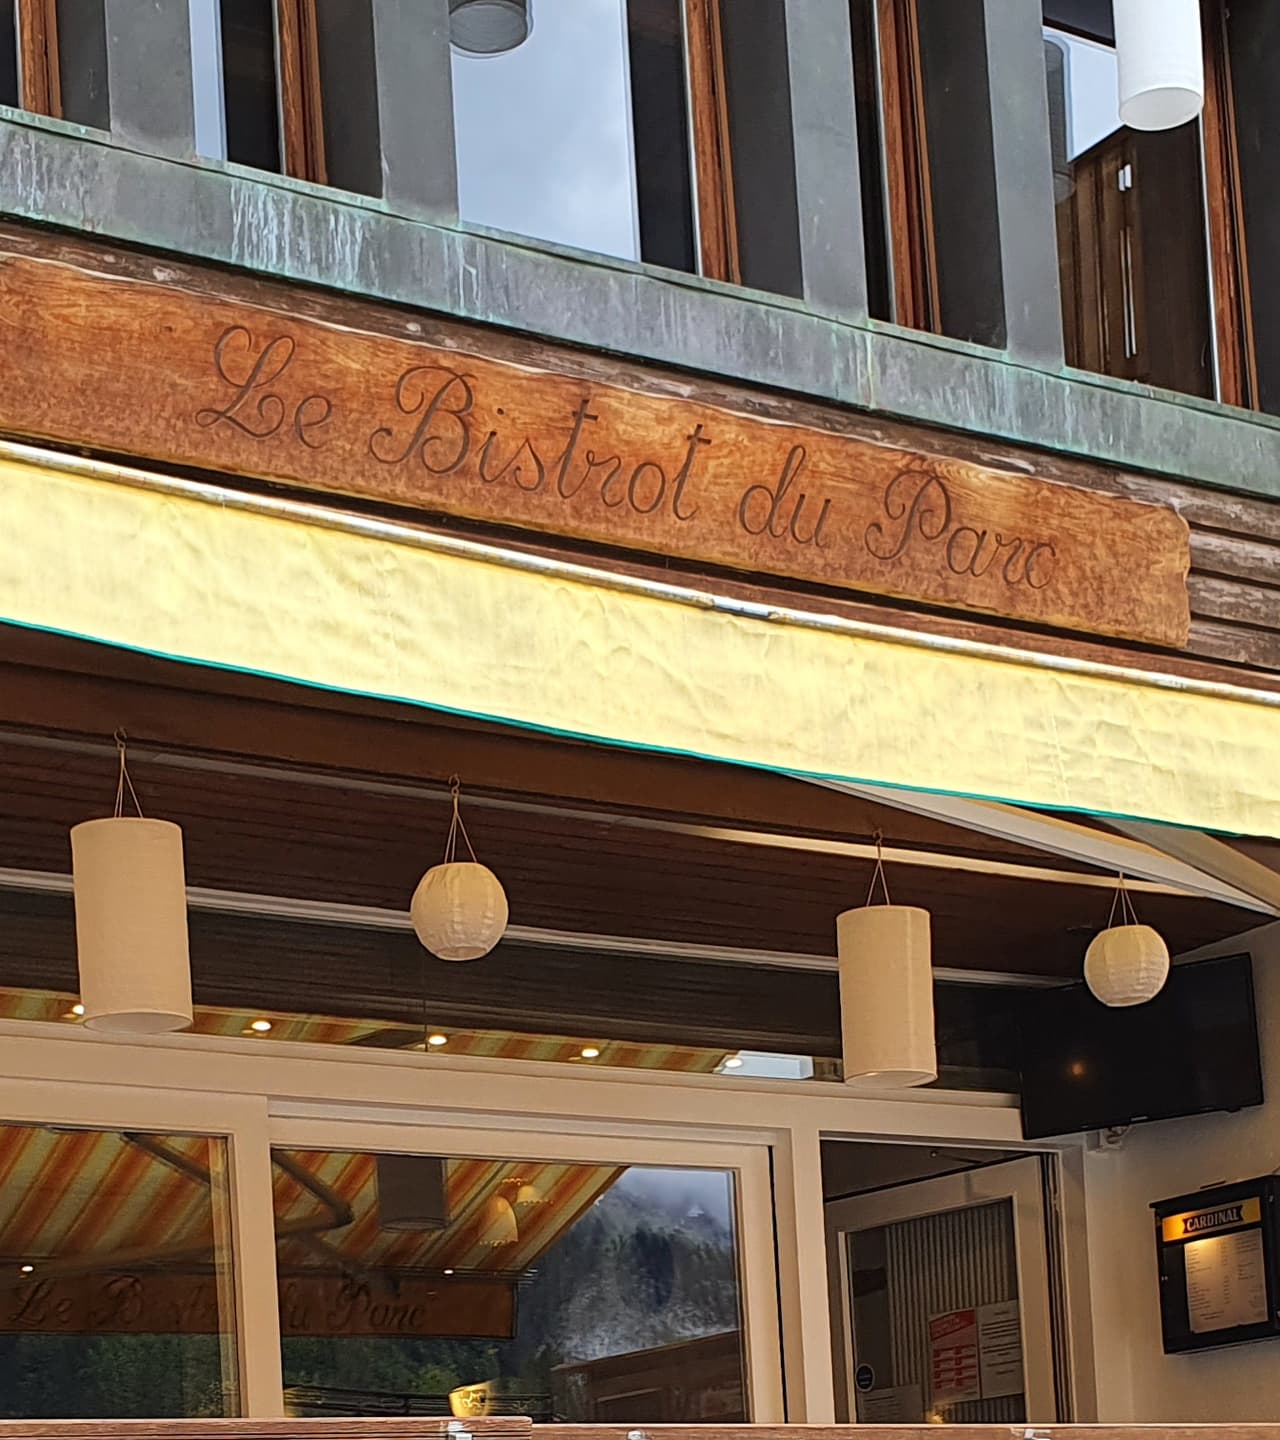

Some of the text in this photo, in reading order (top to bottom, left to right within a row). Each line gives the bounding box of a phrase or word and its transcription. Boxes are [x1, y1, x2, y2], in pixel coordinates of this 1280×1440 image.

[194, 325, 1058, 590] Le Bistrot du Parc
[1185, 1206, 1240, 1232] CARDINAL
